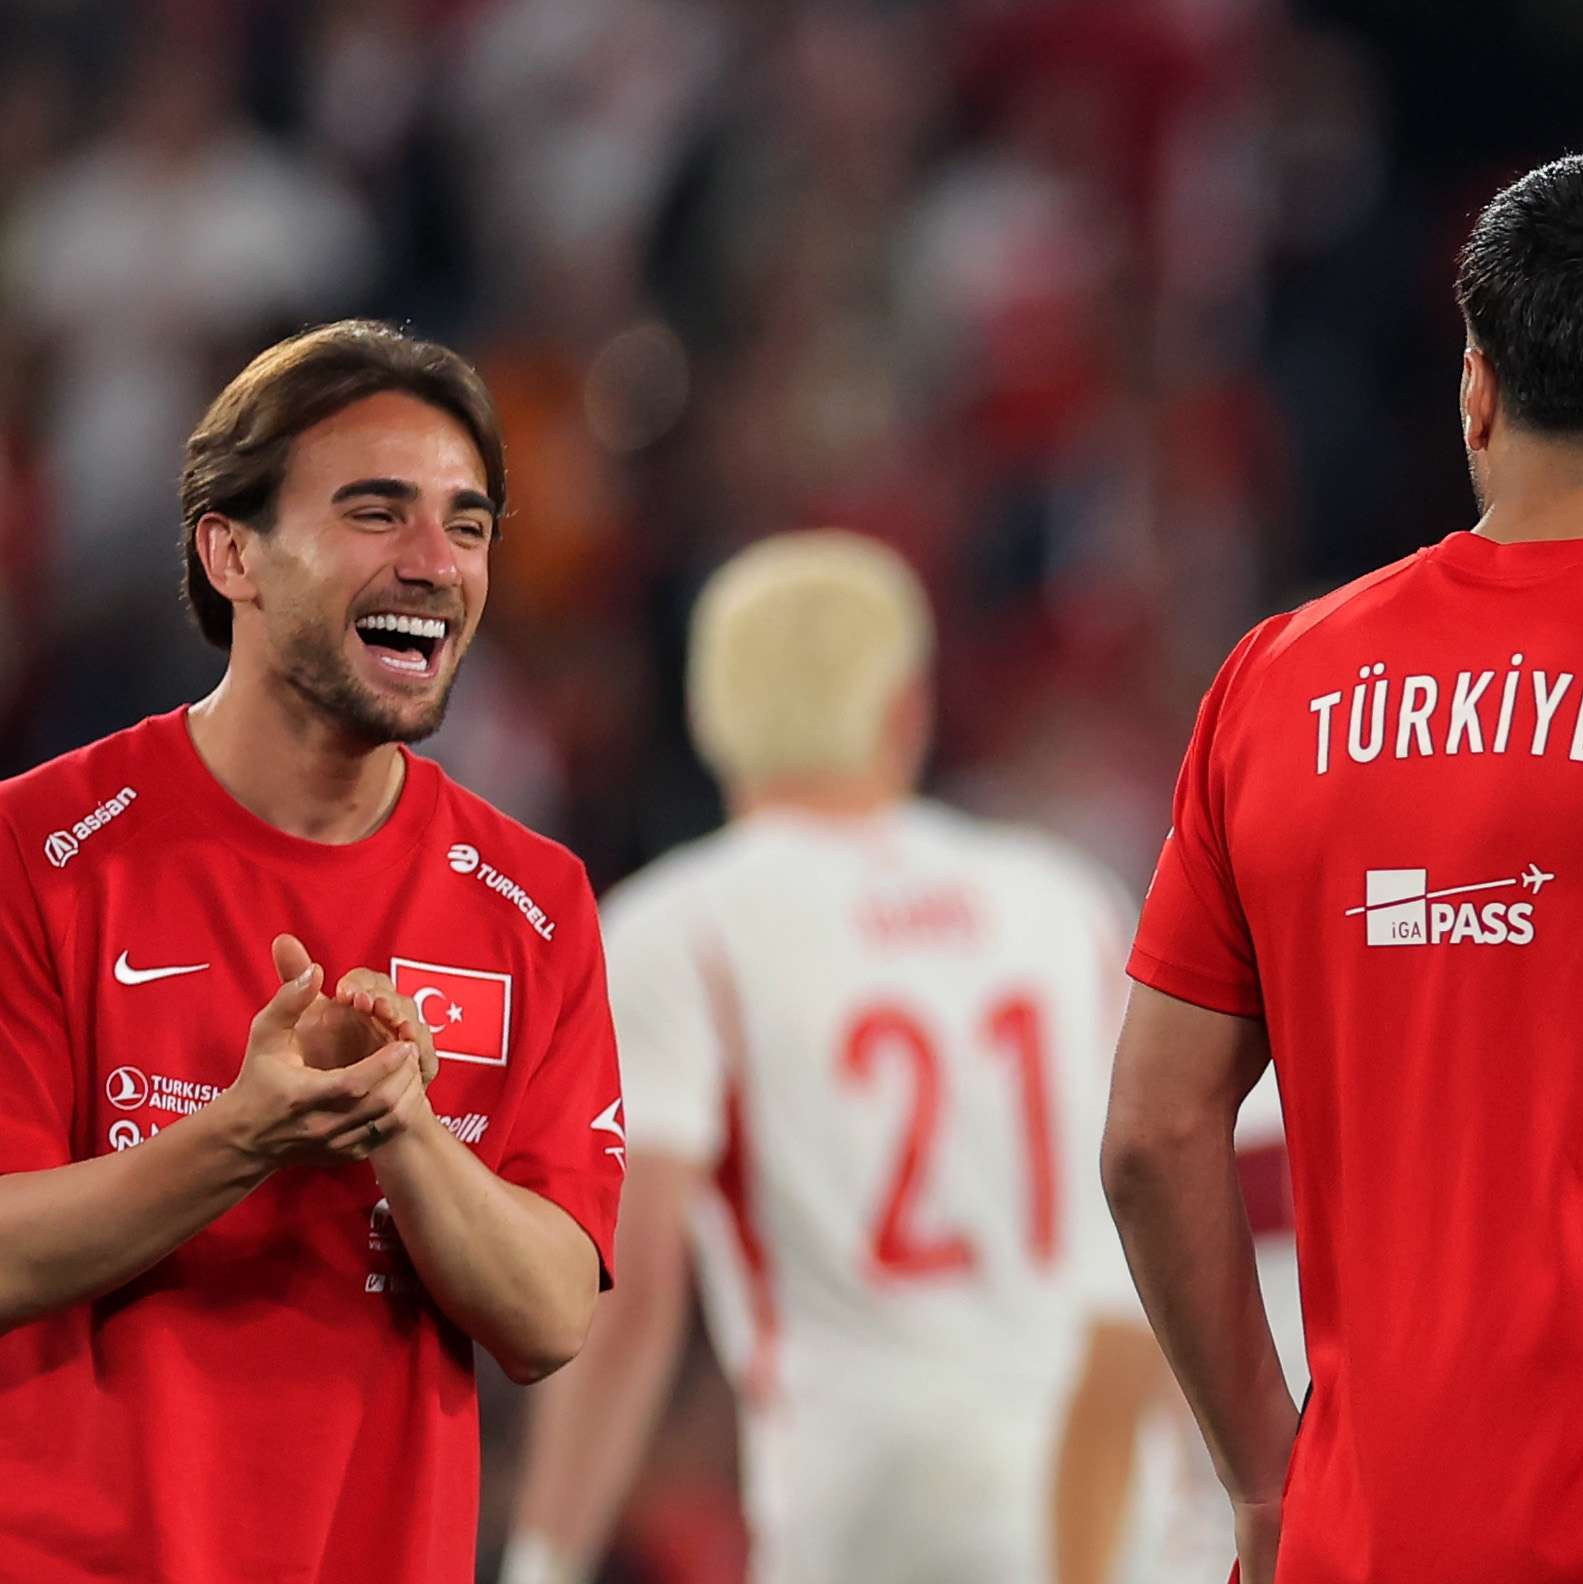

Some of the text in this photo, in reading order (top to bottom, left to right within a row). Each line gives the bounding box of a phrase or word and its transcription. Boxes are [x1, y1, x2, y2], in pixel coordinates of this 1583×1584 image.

[72, 786, 138, 841] assan
[476, 862, 556, 942] TURKCELL
[1391, 902, 1535, 945] iGA PASS
[149, 1092, 208, 1116] AIRLIN
[836, 988, 1063, 1284] 21
